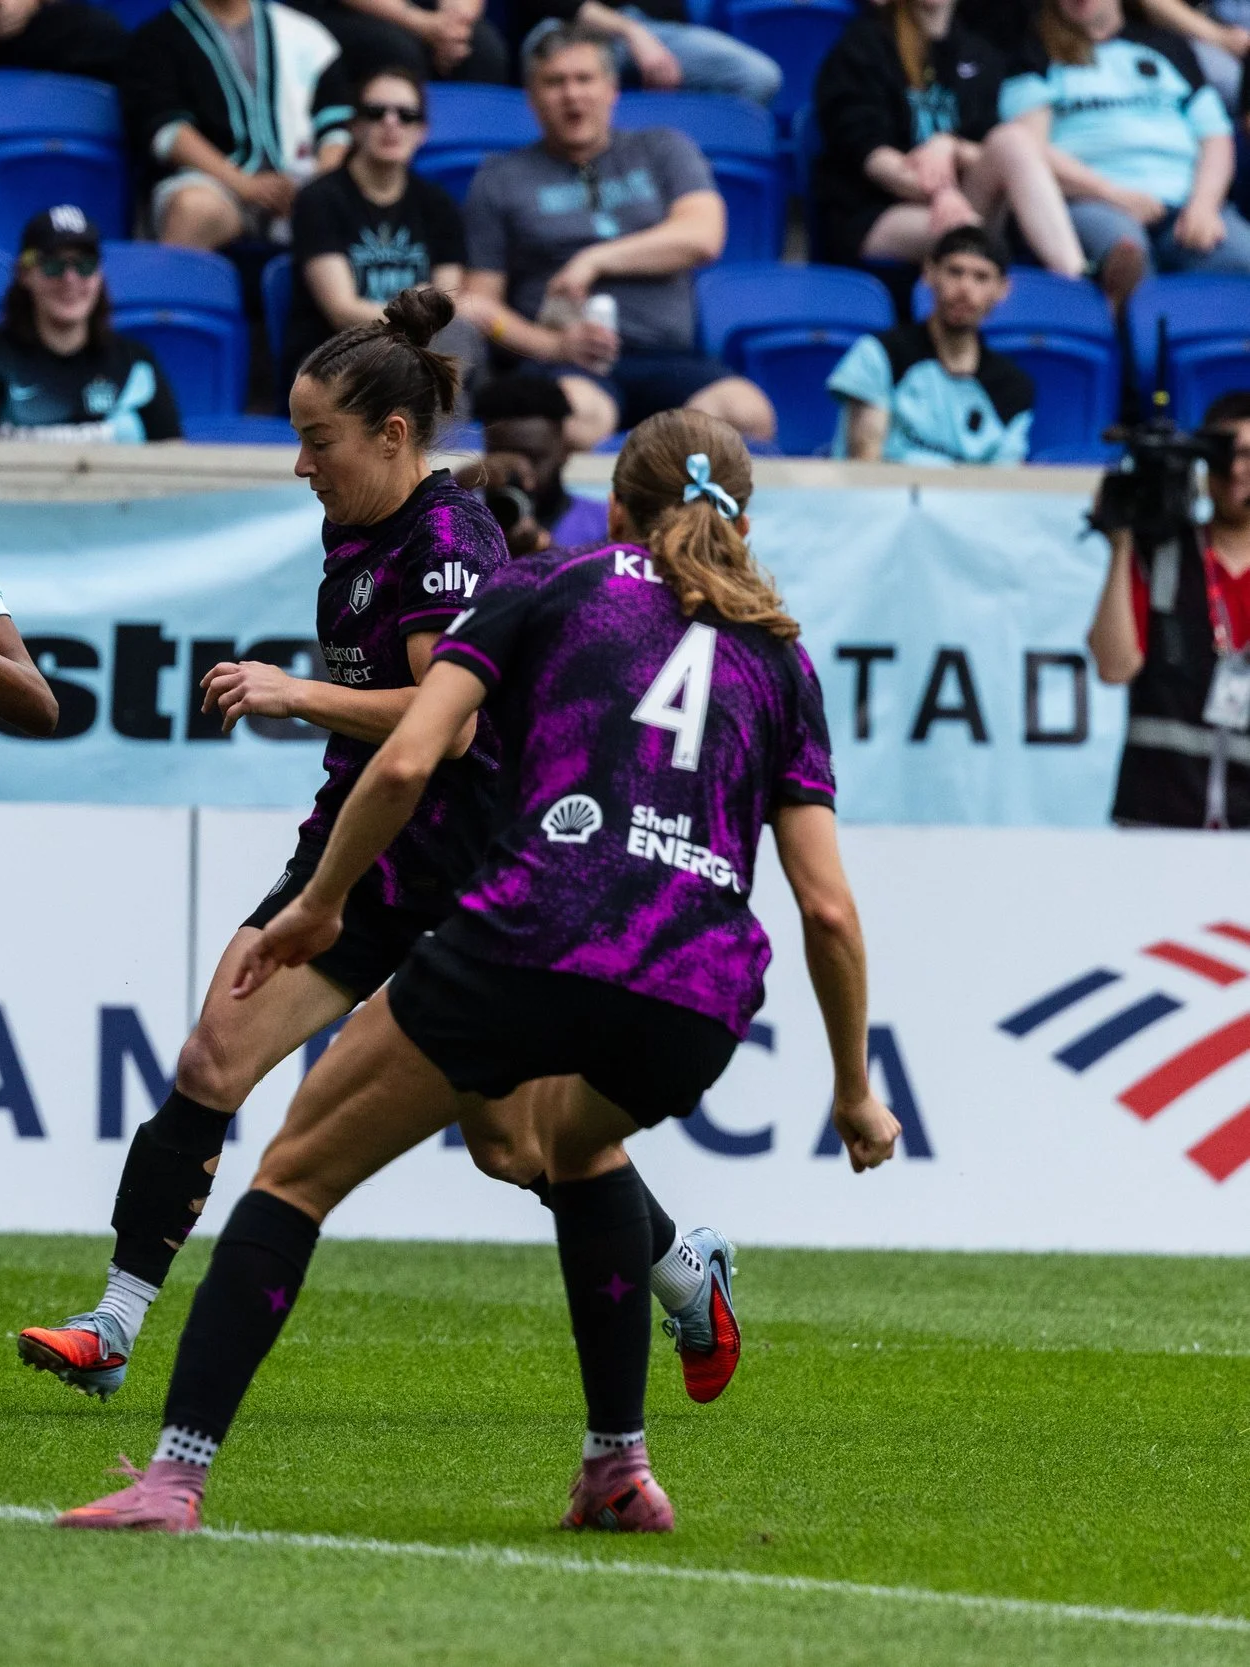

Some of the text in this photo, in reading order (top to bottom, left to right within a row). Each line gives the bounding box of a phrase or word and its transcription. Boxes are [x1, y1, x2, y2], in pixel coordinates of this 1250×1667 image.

[423, 561, 479, 598] ally
[614, 550, 664, 584] KL
[631, 621, 717, 771] 4
[631, 804, 692, 839] Shell
